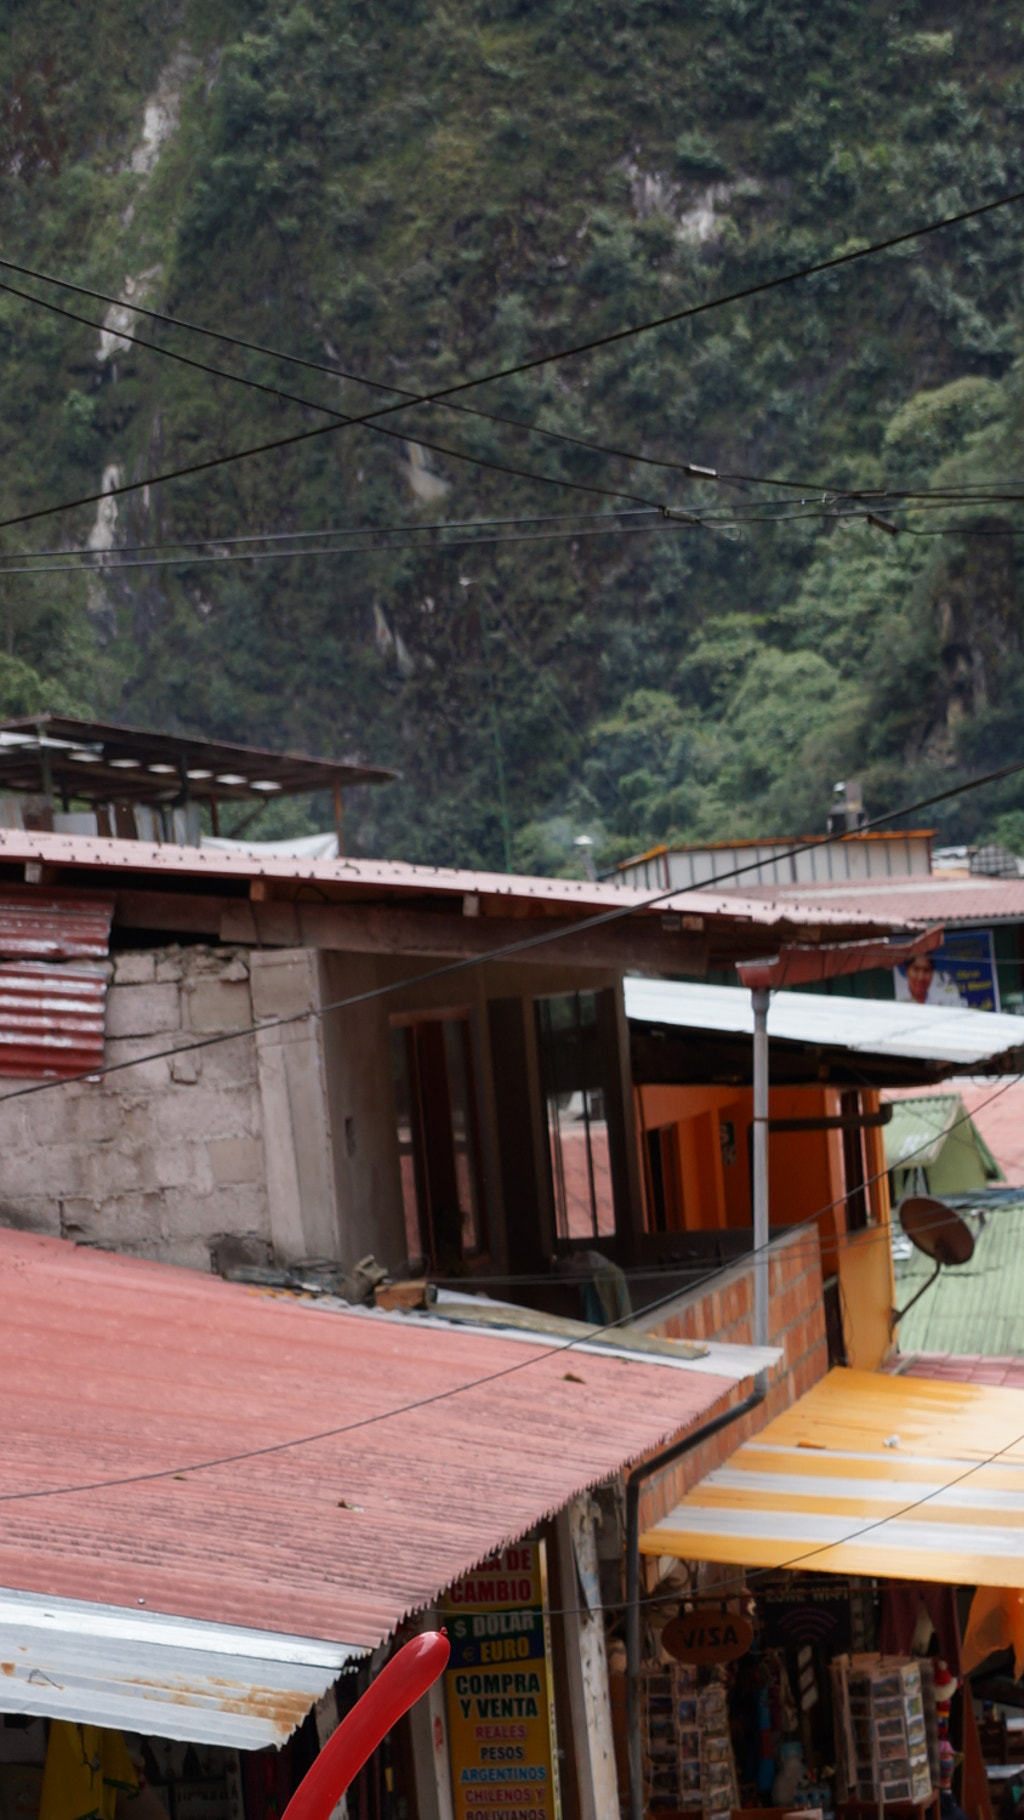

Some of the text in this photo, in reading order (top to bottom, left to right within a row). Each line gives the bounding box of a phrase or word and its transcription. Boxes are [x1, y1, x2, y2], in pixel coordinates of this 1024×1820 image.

[506, 1549, 532, 1571] DE
[451, 1579, 532, 1604] CAMBIO
[472, 1610, 535, 1638] DOLAR
[680, 1625, 739, 1649] VISA
[480, 1637, 530, 1663] EURO
[455, 1673, 541, 1696] COMPRA
[459, 1698, 539, 1720] Y VENTA
[475, 1725, 526, 1741] REALES
[480, 1747, 524, 1761] PESOS
[461, 1766, 547, 1783] ARGENTINOS
[465, 1787, 545, 1804] CHILENOS Y
